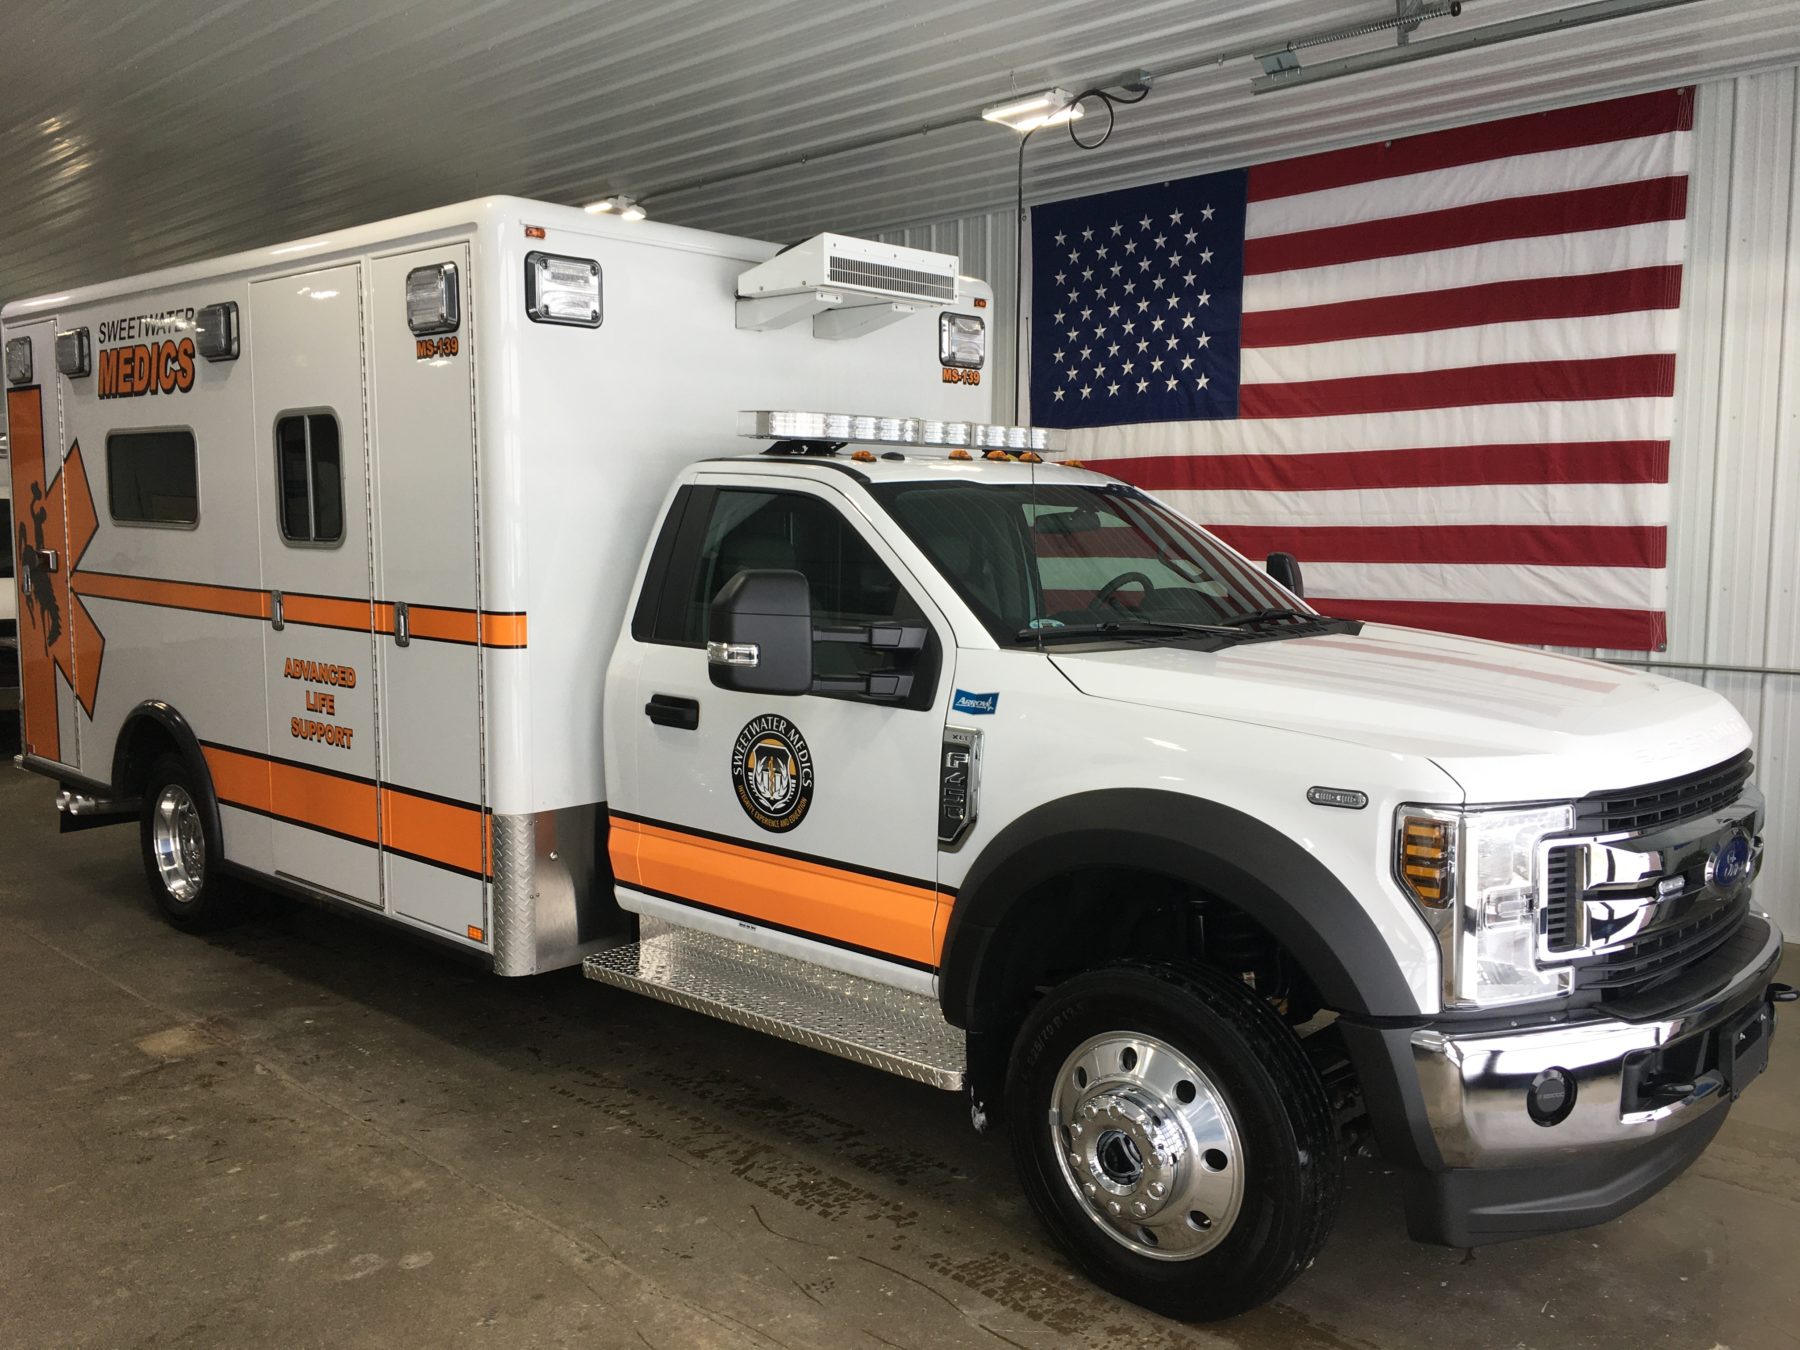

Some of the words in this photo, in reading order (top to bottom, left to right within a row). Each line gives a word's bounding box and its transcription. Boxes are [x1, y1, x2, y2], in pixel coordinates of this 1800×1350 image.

[416, 335, 459, 360] MS-139
[98, 337, 196, 400] MEDICS
[942, 367, 981, 386] MS-139
[284, 657, 356, 689] ADVANCED
[305, 690, 335, 716] LIFE
[291, 716, 353, 750] SUPPORT
[733, 716, 787, 776] SWEETWATER
[787, 728, 813, 788] MEDICS
